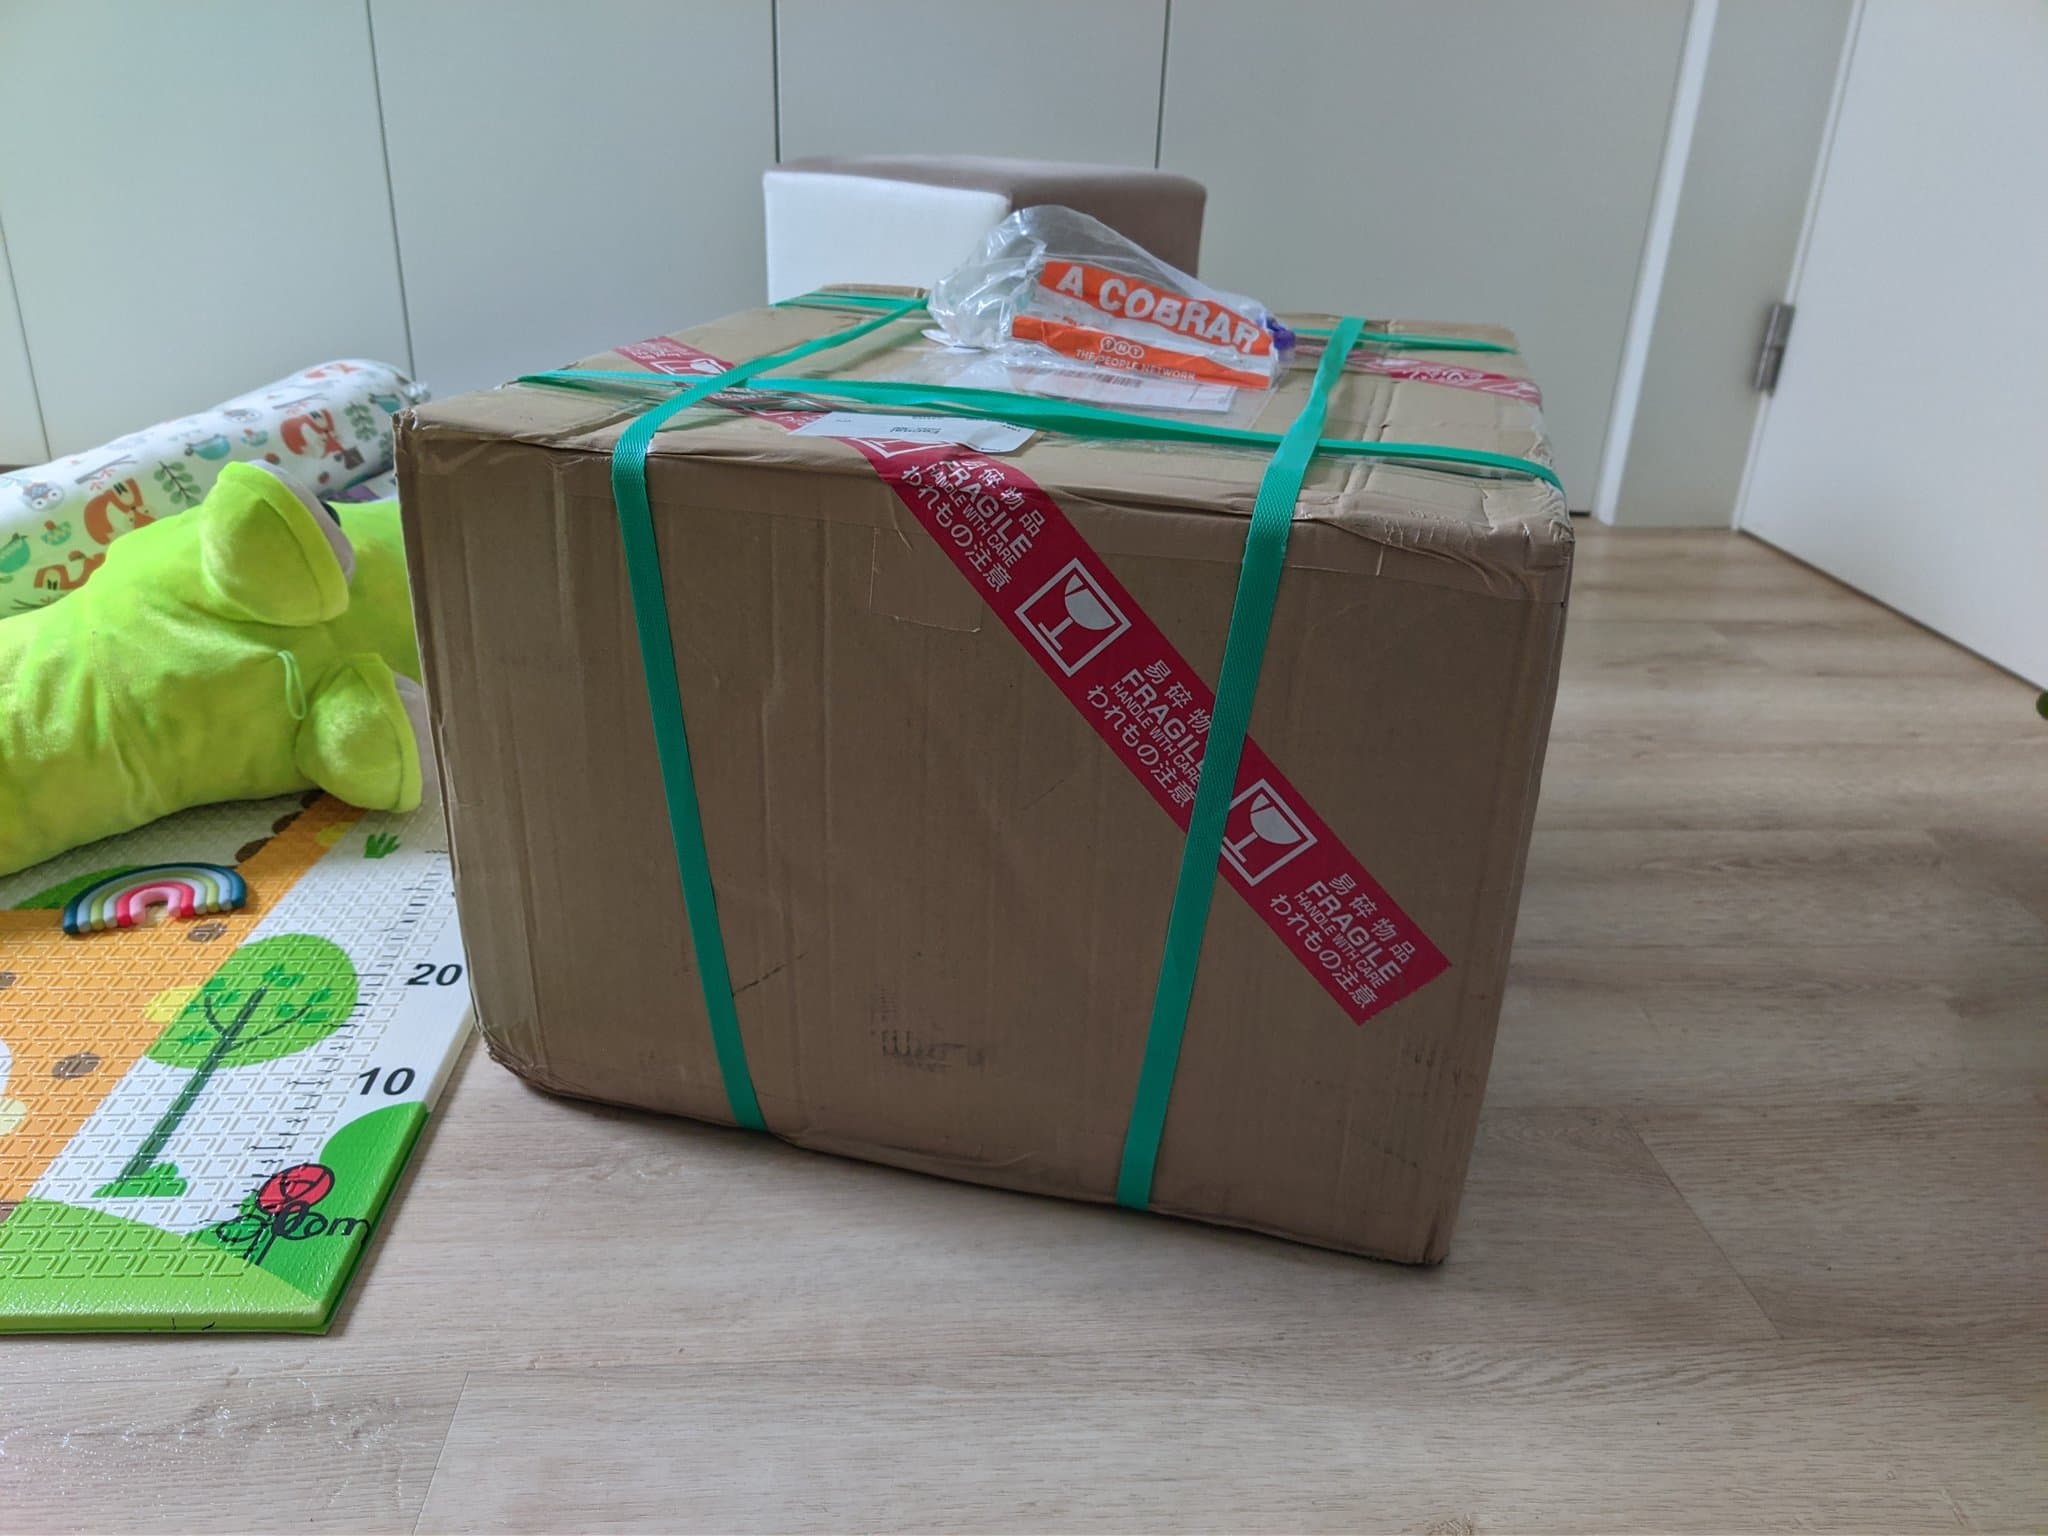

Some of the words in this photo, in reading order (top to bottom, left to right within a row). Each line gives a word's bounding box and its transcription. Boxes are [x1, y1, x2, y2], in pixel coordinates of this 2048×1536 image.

[1056, 266, 1084, 298] A
[1100, 279, 1261, 353] COBRAR
[1076, 349, 1095, 363] THE
[1097, 355, 1139, 373] PEOPLE
[1141, 362, 1197, 381] NETWORK
[901, 465, 1012, 592] われもの注意
[926, 463, 967, 508] HANDLE
[962, 503, 991, 536] WITH
[986, 533, 1018, 568] CARE
[938, 459, 1033, 559] FRAGILE
[1110, 681, 1152, 728] HANDLE
[1149, 724, 1178, 757] WITH
[1121, 668, 1203, 771] FRAGIL
[1144, 659, 1212, 734] 易碎物
[1087, 685, 1197, 808] われもの注意
[1269, 893, 1378, 1009] われもの注意
[1294, 891, 1337, 936] HANDLE
[1331, 932, 1360, 961] WITH
[1355, 959, 1386, 989] CARE
[1305, 880, 1402, 982] FRAGILE
[1328, 872, 1416, 964] 易碎物品
[405, 963, 463, 986] 20
[358, 1067, 416, 1096] 10
